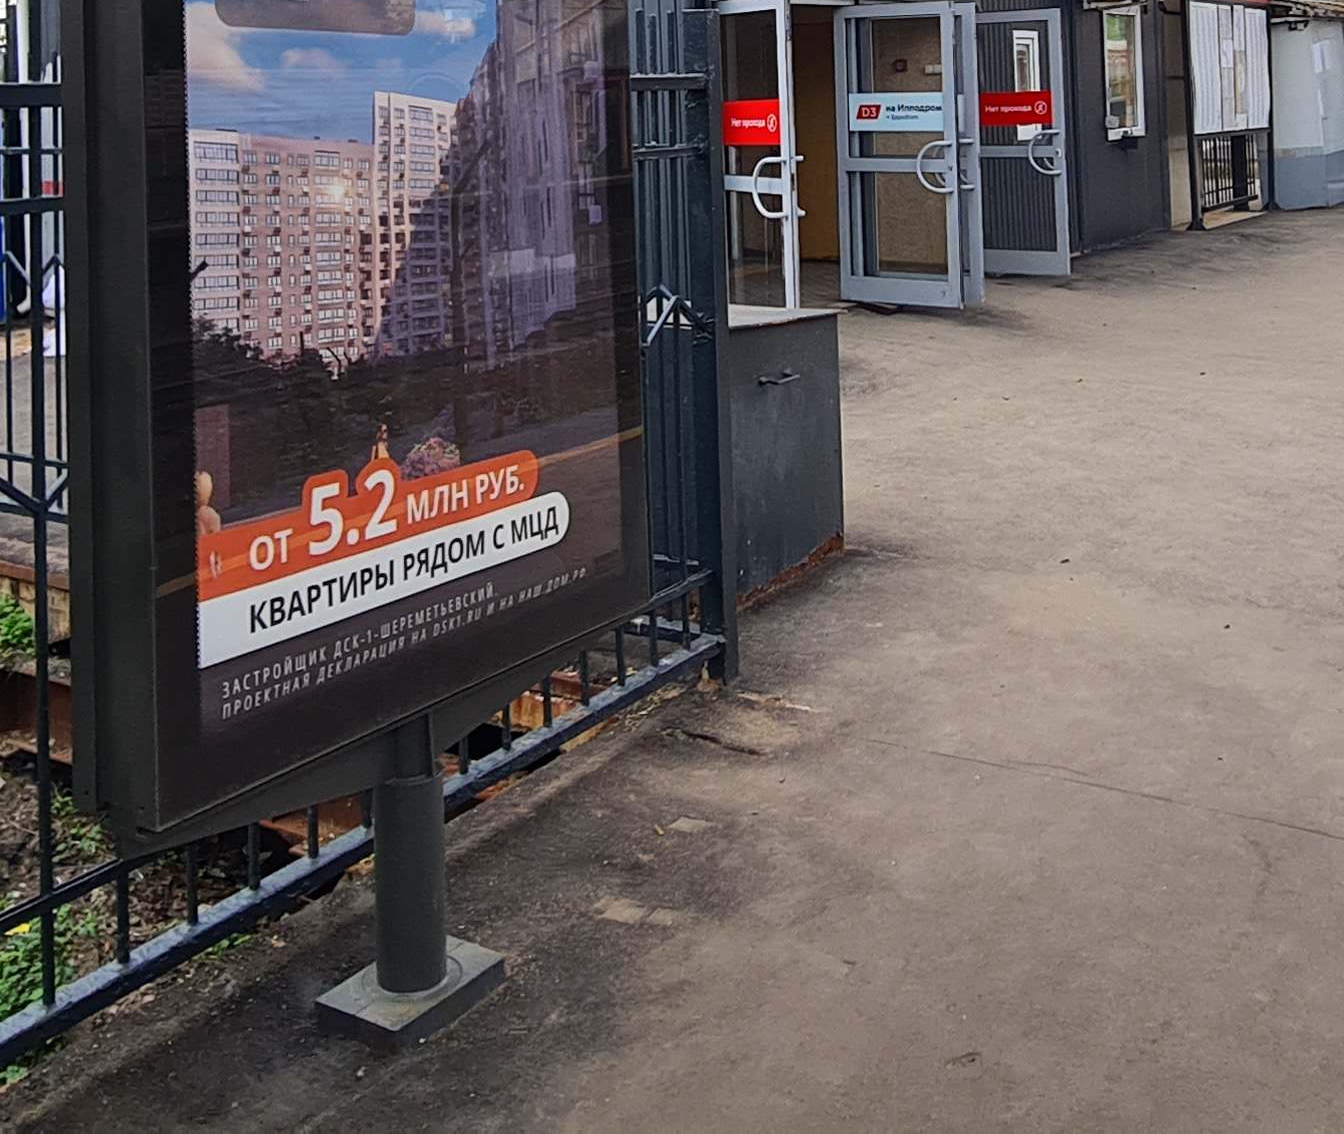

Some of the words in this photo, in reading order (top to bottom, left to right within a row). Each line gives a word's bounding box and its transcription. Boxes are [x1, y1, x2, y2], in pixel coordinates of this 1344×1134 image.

[861, 107, 877, 118] D3
[249, 528, 293, 570] ОТ
[309, 468, 398, 556] 5.2
[407, 482, 469, 524] МЛН
[475, 464, 525, 505] РУБ.
[249, 560, 394, 633] КВАРТИРЫ
[403, 530, 485, 581] РЯДОМ
[493, 524, 505, 550] С
[511, 506, 559, 544] МЦД
[222, 673, 310, 719] ПРОЕКТНАЯ
[316, 637, 405, 685] ДЕКЛАРАЦИЯ
[411, 629, 427, 645] НА
[433, 608, 482, 637] DSK1.RU
[486, 603, 496, 616] И
[499, 595, 514, 611] НА
[222, 646, 327, 699] ЗАСТРОЙЩИК
